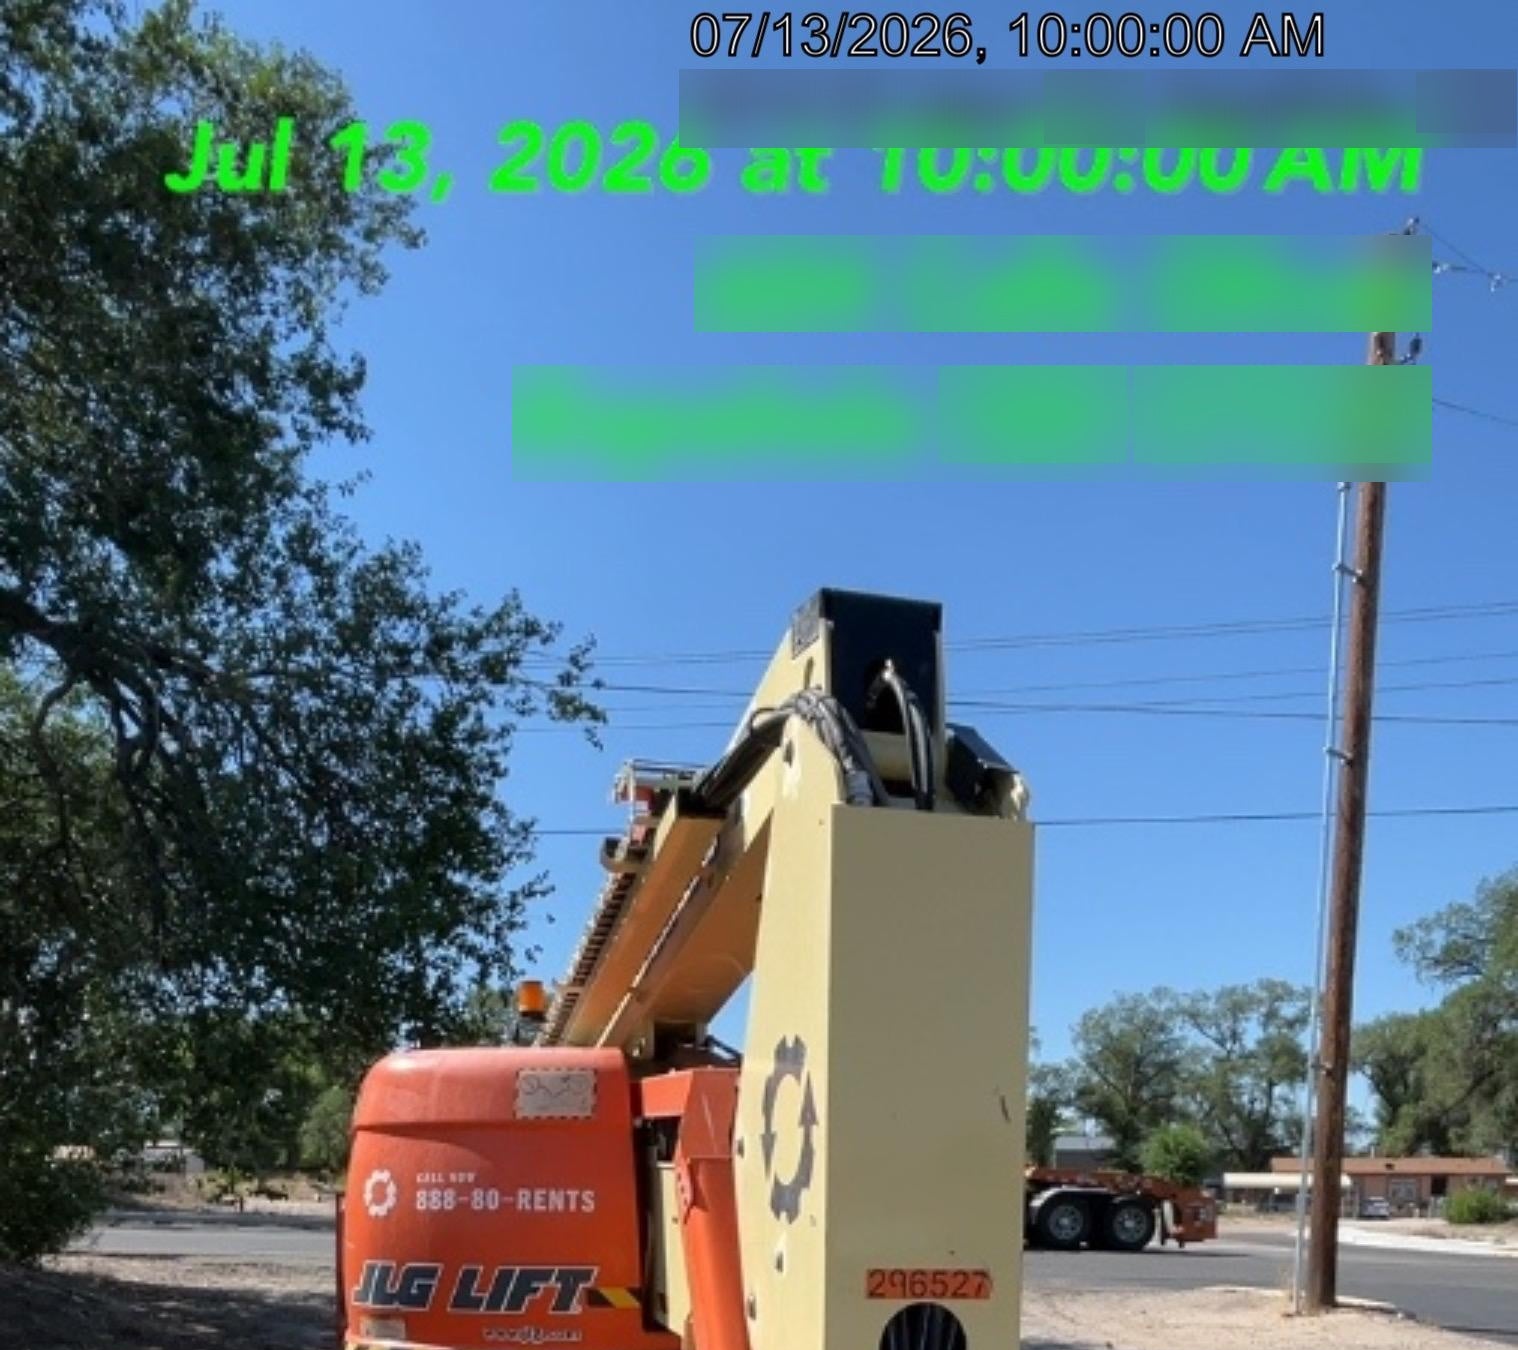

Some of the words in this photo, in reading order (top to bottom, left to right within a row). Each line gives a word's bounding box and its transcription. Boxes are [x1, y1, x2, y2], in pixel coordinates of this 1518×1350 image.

[416, 1172, 444, 1184] CALL
[415, 1187, 596, 1213] 888-80-RENTS
[351, 1259, 444, 1312] JLG
[447, 1263, 600, 1315] LIFT
[868, 1269, 991, 1299] 296527
